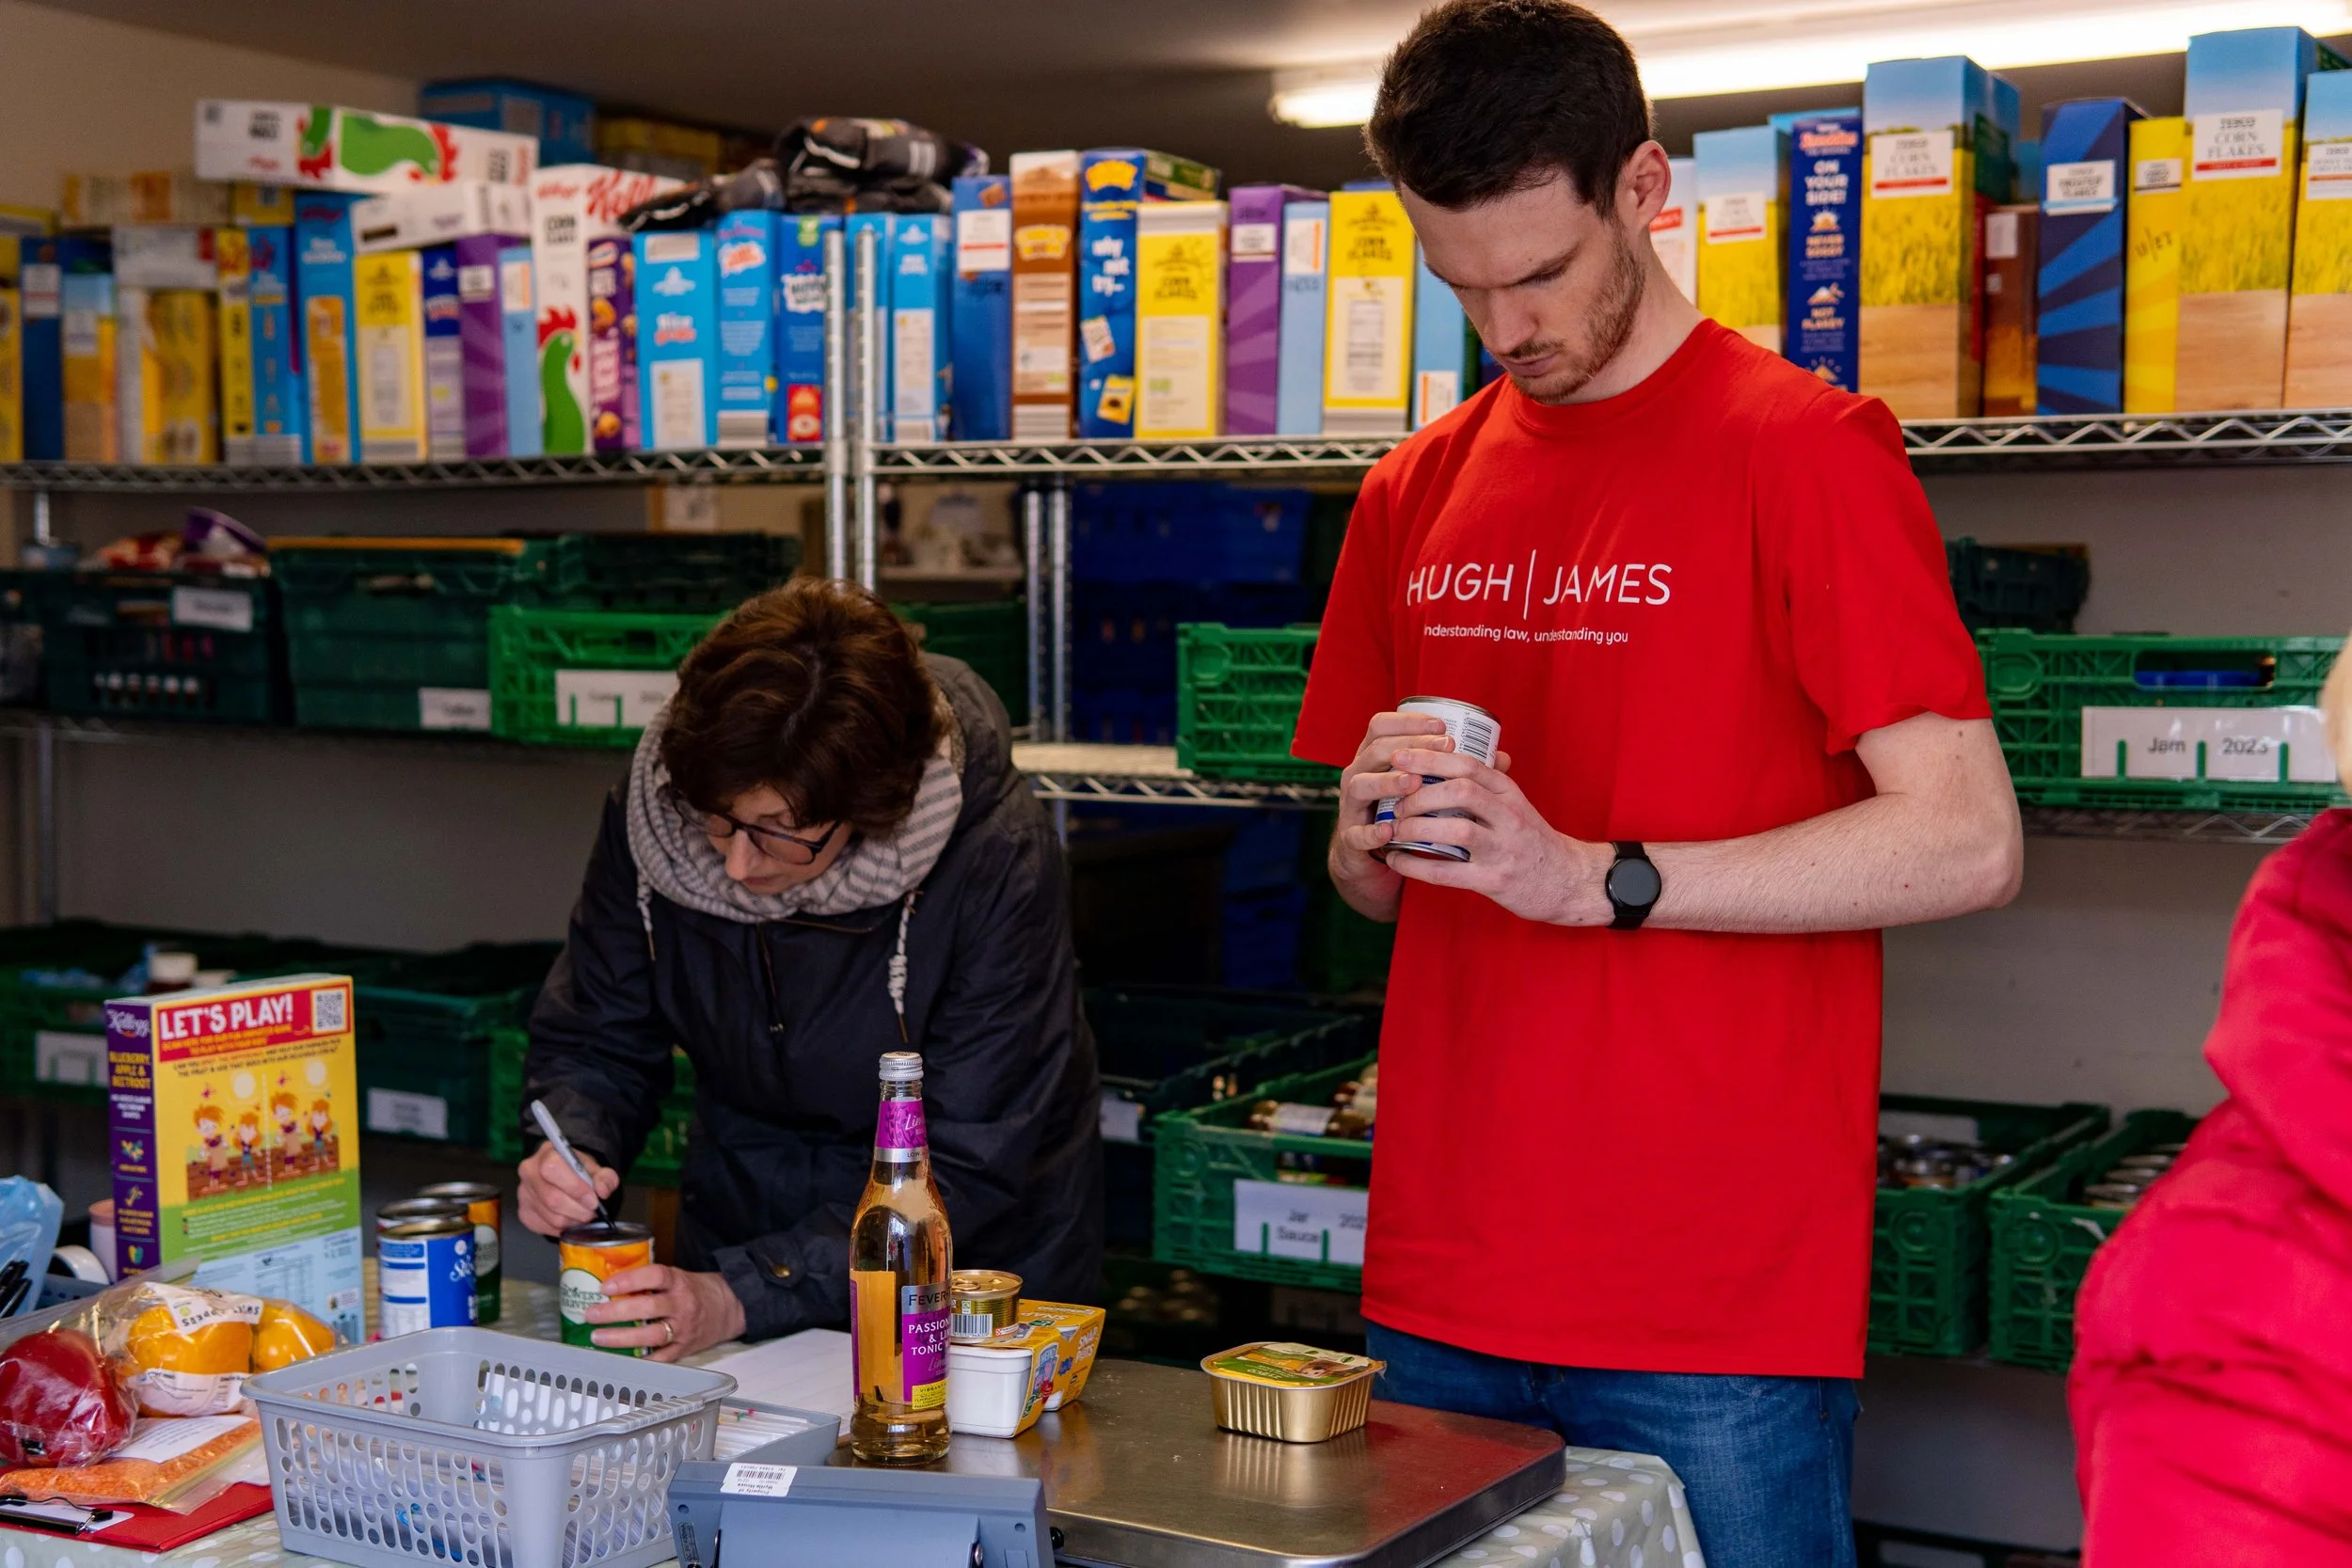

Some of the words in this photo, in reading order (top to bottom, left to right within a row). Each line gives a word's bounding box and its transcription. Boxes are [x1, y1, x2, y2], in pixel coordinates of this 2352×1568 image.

[2213, 130, 2257, 145] CORN
[2207, 143, 2265, 160] FLAKES
[1804, 174, 1849, 189] YOUR
[1406, 563, 1514, 606] HUGH
[1543, 563, 1672, 605] JAMES
[1503, 626, 1531, 643] law,
[1606, 632, 1629, 644] you
[2148, 737, 2186, 753] Jam
[159, 1006, 227, 1040] LET'S
[230, 993, 294, 1029] PLAY!
[1288, 1209, 1310, 1223] Jar
[1277, 1225, 1319, 1243] Sauce
[929, 1333, 937, 1344] &
[911, 1344, 943, 1355] TONIC
